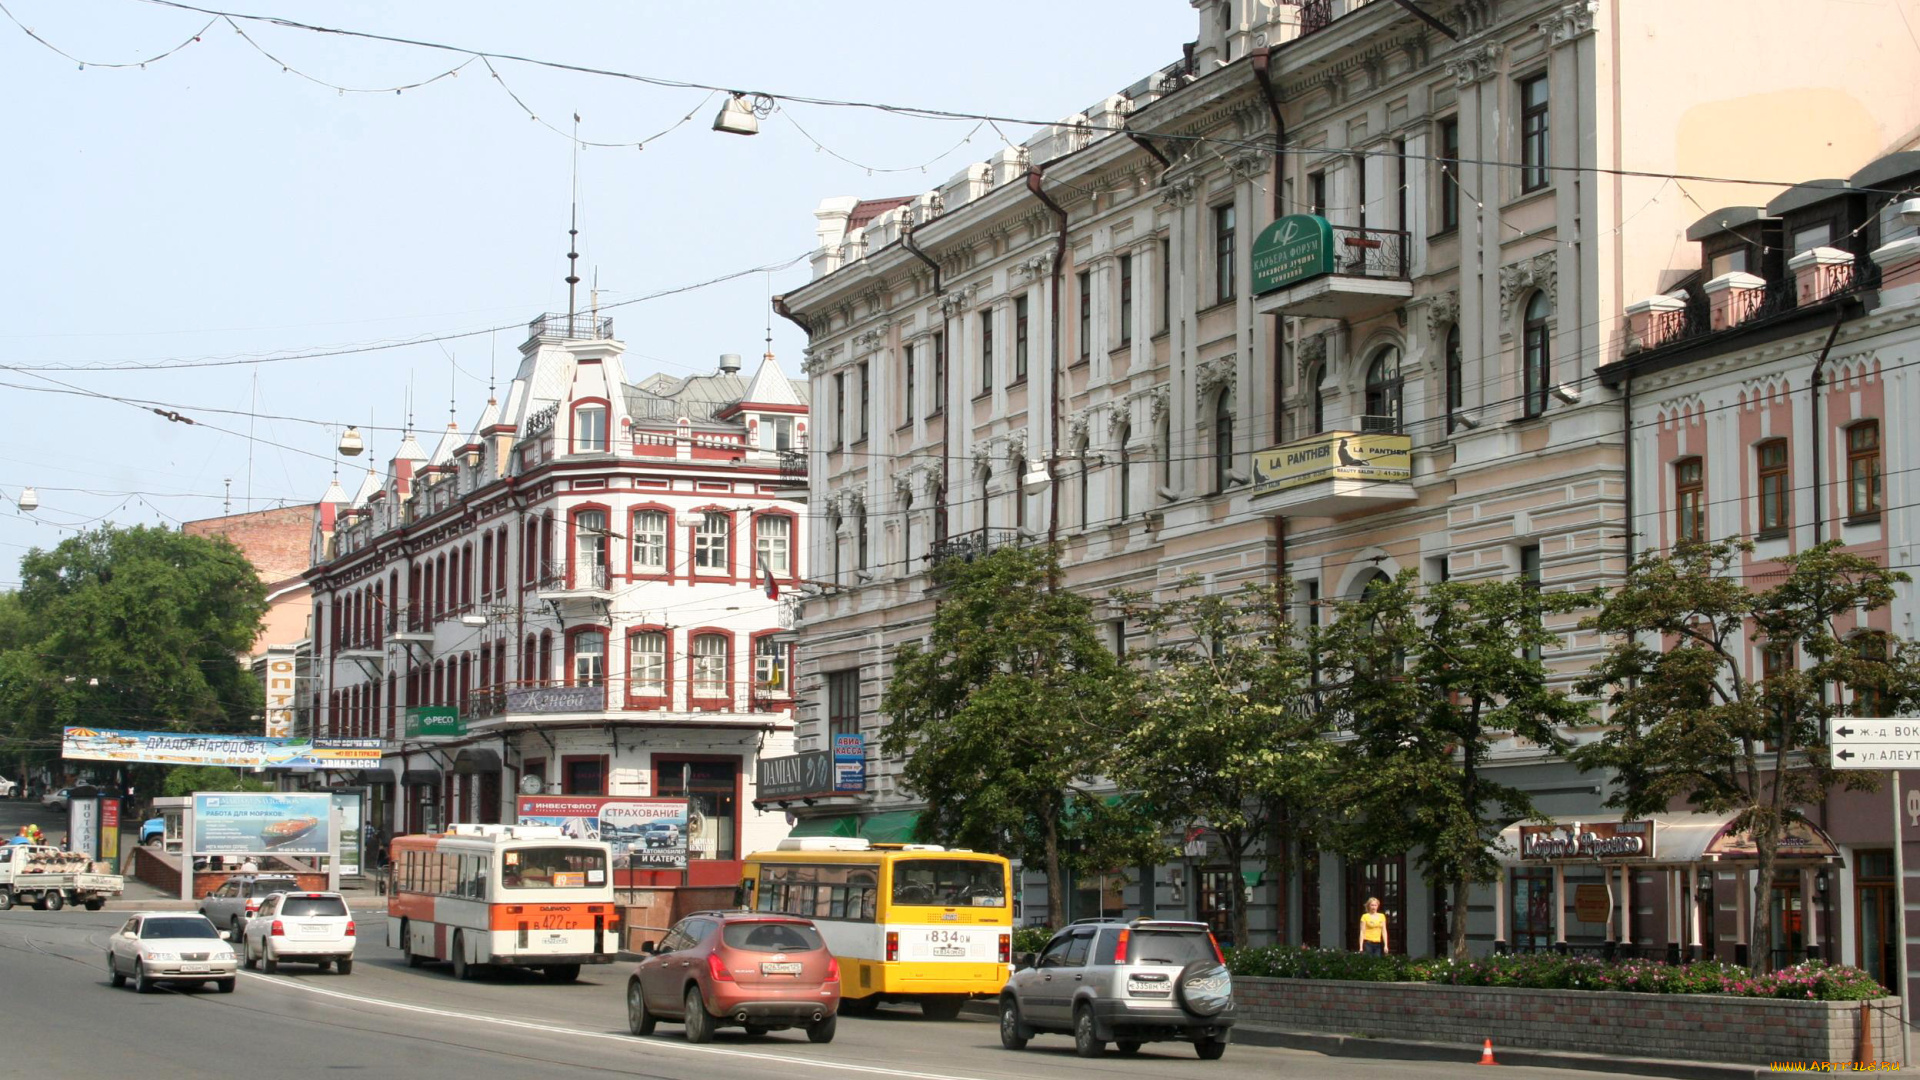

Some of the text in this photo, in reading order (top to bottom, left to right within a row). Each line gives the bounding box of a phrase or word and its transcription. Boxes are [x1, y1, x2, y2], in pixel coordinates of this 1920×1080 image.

[1253, 240, 1318, 271] КАРЬЕРА ФОРУМ
[1269, 445, 1330, 470] LA PANTHER
[1369, 447, 1407, 455] PANTHER
[521, 691, 586, 711] Женева
[432, 715, 454, 724] РЕСО
[836, 747, 862, 755] КАССА
[605, 808, 680, 818] СТРАХОВАНИЕ
[641, 854, 686, 863] И КАТЕРОВ
[555, 874, 567, 887] 49
[542, 914, 564, 930] 422
[931, 930, 958, 943] 834
